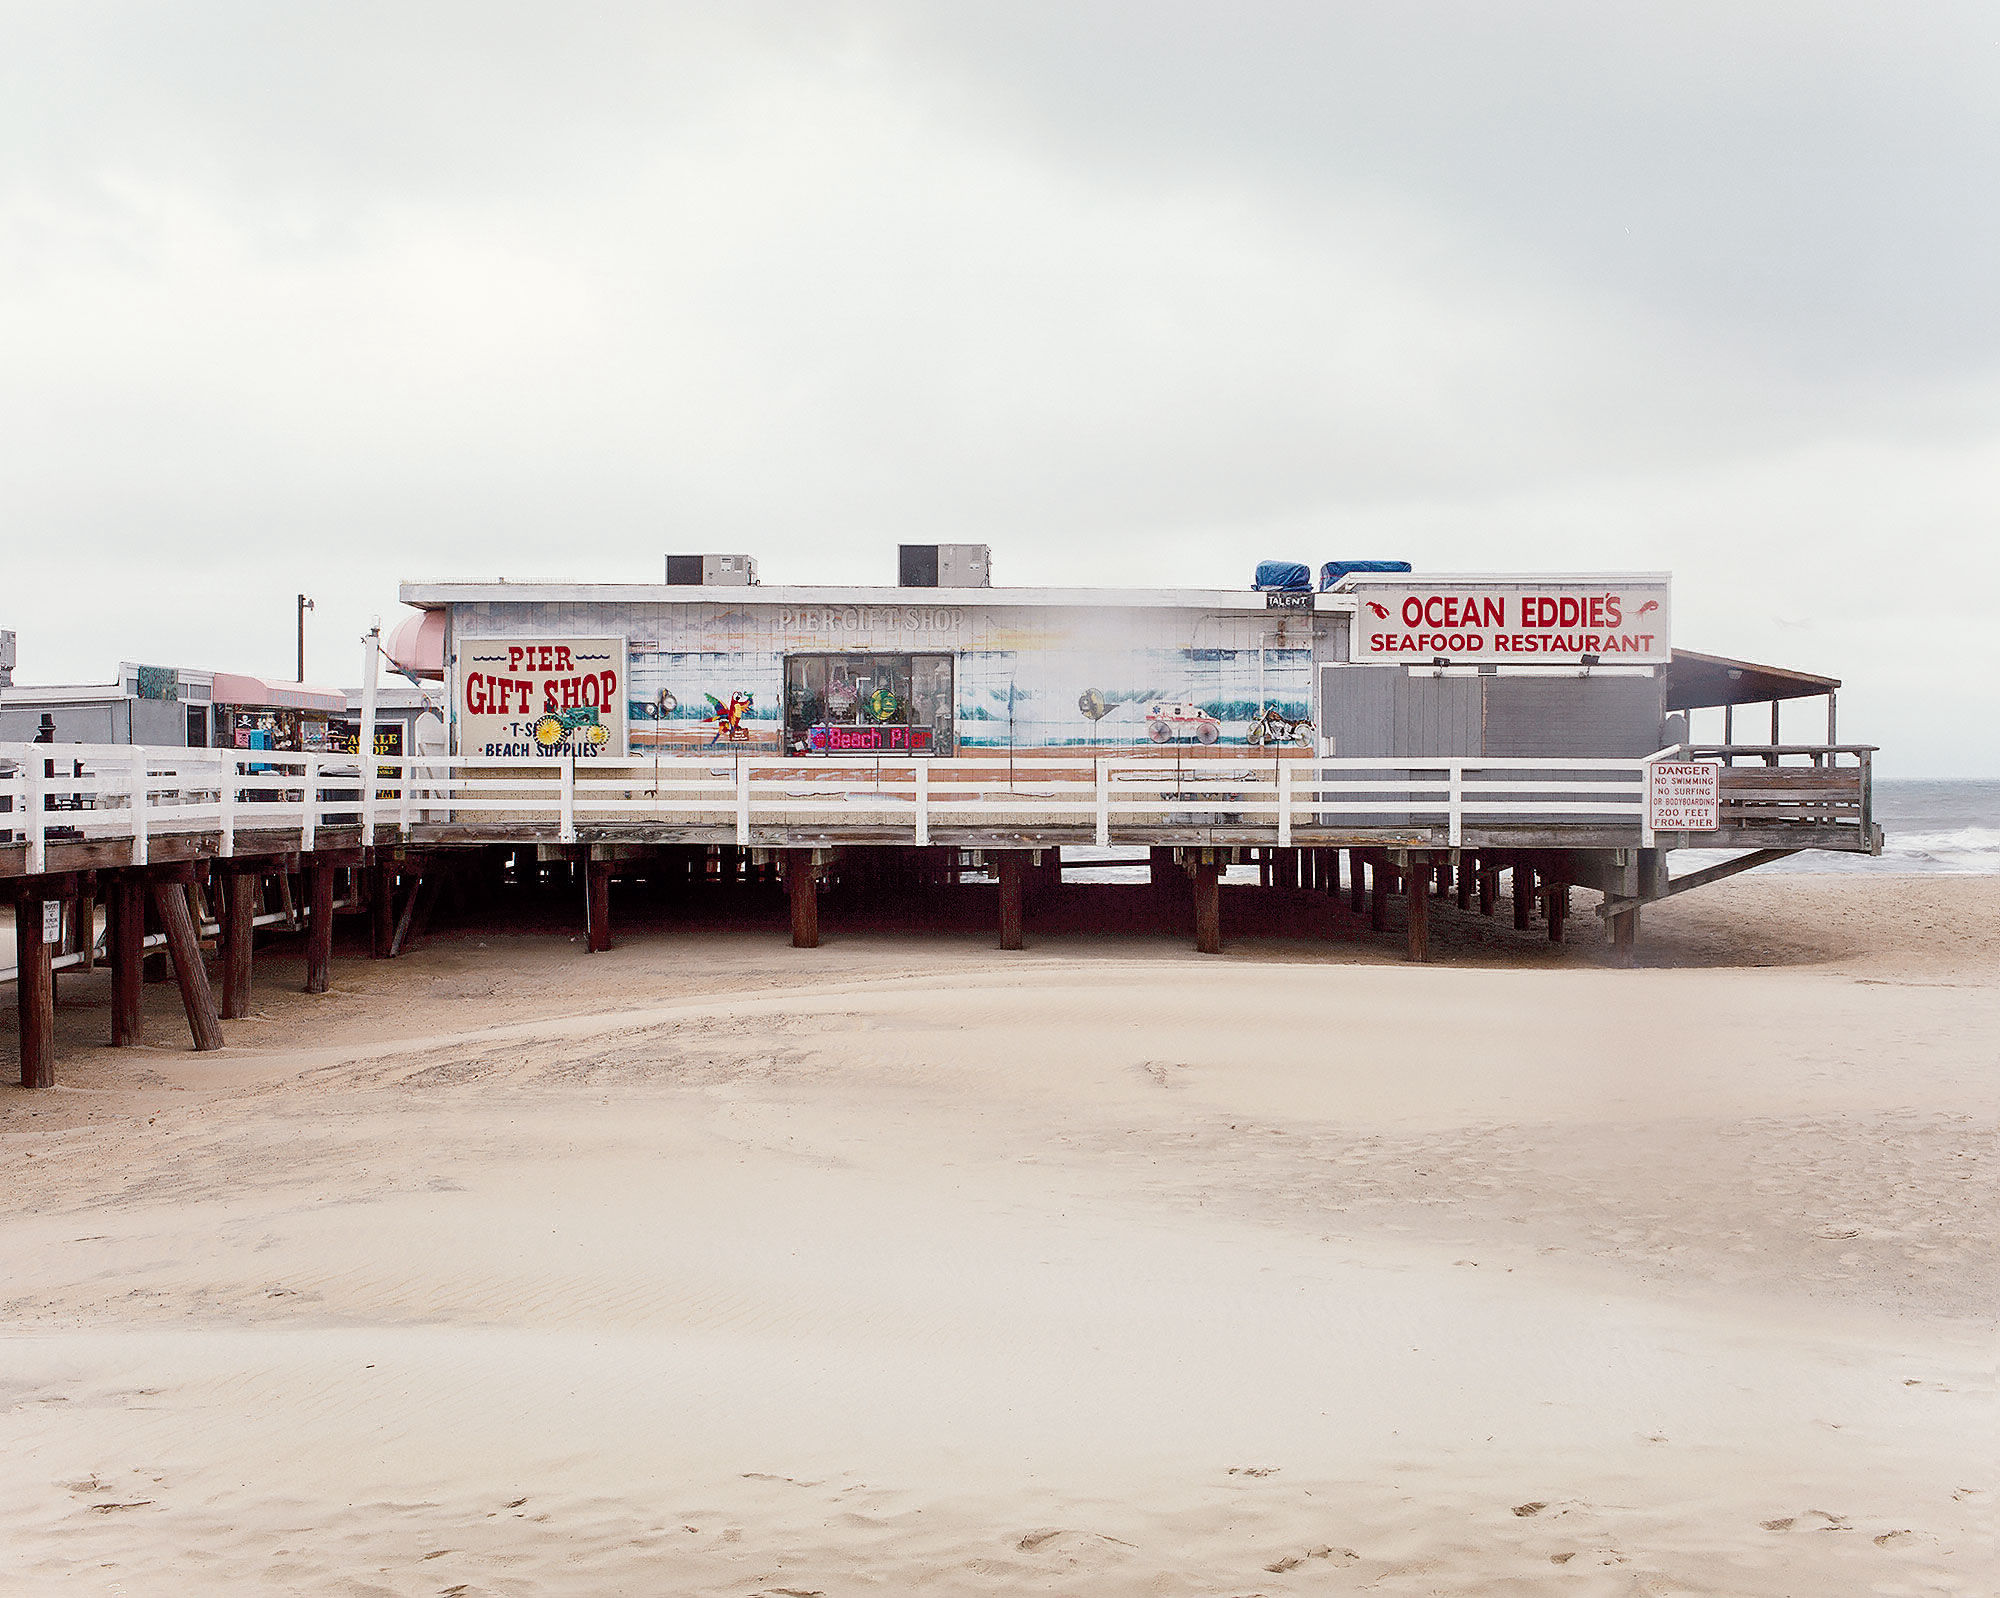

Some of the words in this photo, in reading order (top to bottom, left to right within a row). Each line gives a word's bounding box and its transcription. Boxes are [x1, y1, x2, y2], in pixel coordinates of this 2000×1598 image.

[1268, 596, 1308, 606] TALENT
[1401, 596, 1505, 628] OCEAN
[1521, 592, 1623, 628] EDDIE'S
[777, 607, 837, 632] PIER
[841, 606, 900, 632] GIFT
[904, 606, 964, 632] SHOP
[1370, 633, 1484, 652] SEAFOOD
[1494, 634, 1655, 653] RESTAURANT
[508, 646, 575, 672] PIER
[466, 671, 534, 715] GIFT
[543, 670, 617, 714] SHOP
[830, 727, 882, 749] Beach
[890, 727, 932, 749] Pier
[485, 743, 530, 757] BEACH
[536, 743, 599, 757] SUPPLIES
[1658, 766, 1710, 775] DANGER
[1654, 777, 1667, 785] NO
[1671, 777, 1714, 785] SWIMMING
[1657, 787, 1670, 795] NO
[1674, 787, 1711, 795] SURFING
[1653, 797, 1663, 805] OR
[1665, 797, 1715, 805] BODYBOARDING
[1658, 808, 1679, 816] 200
[1685, 808, 1709, 816] FEET
[1688, 818, 1713, 827] PIER
